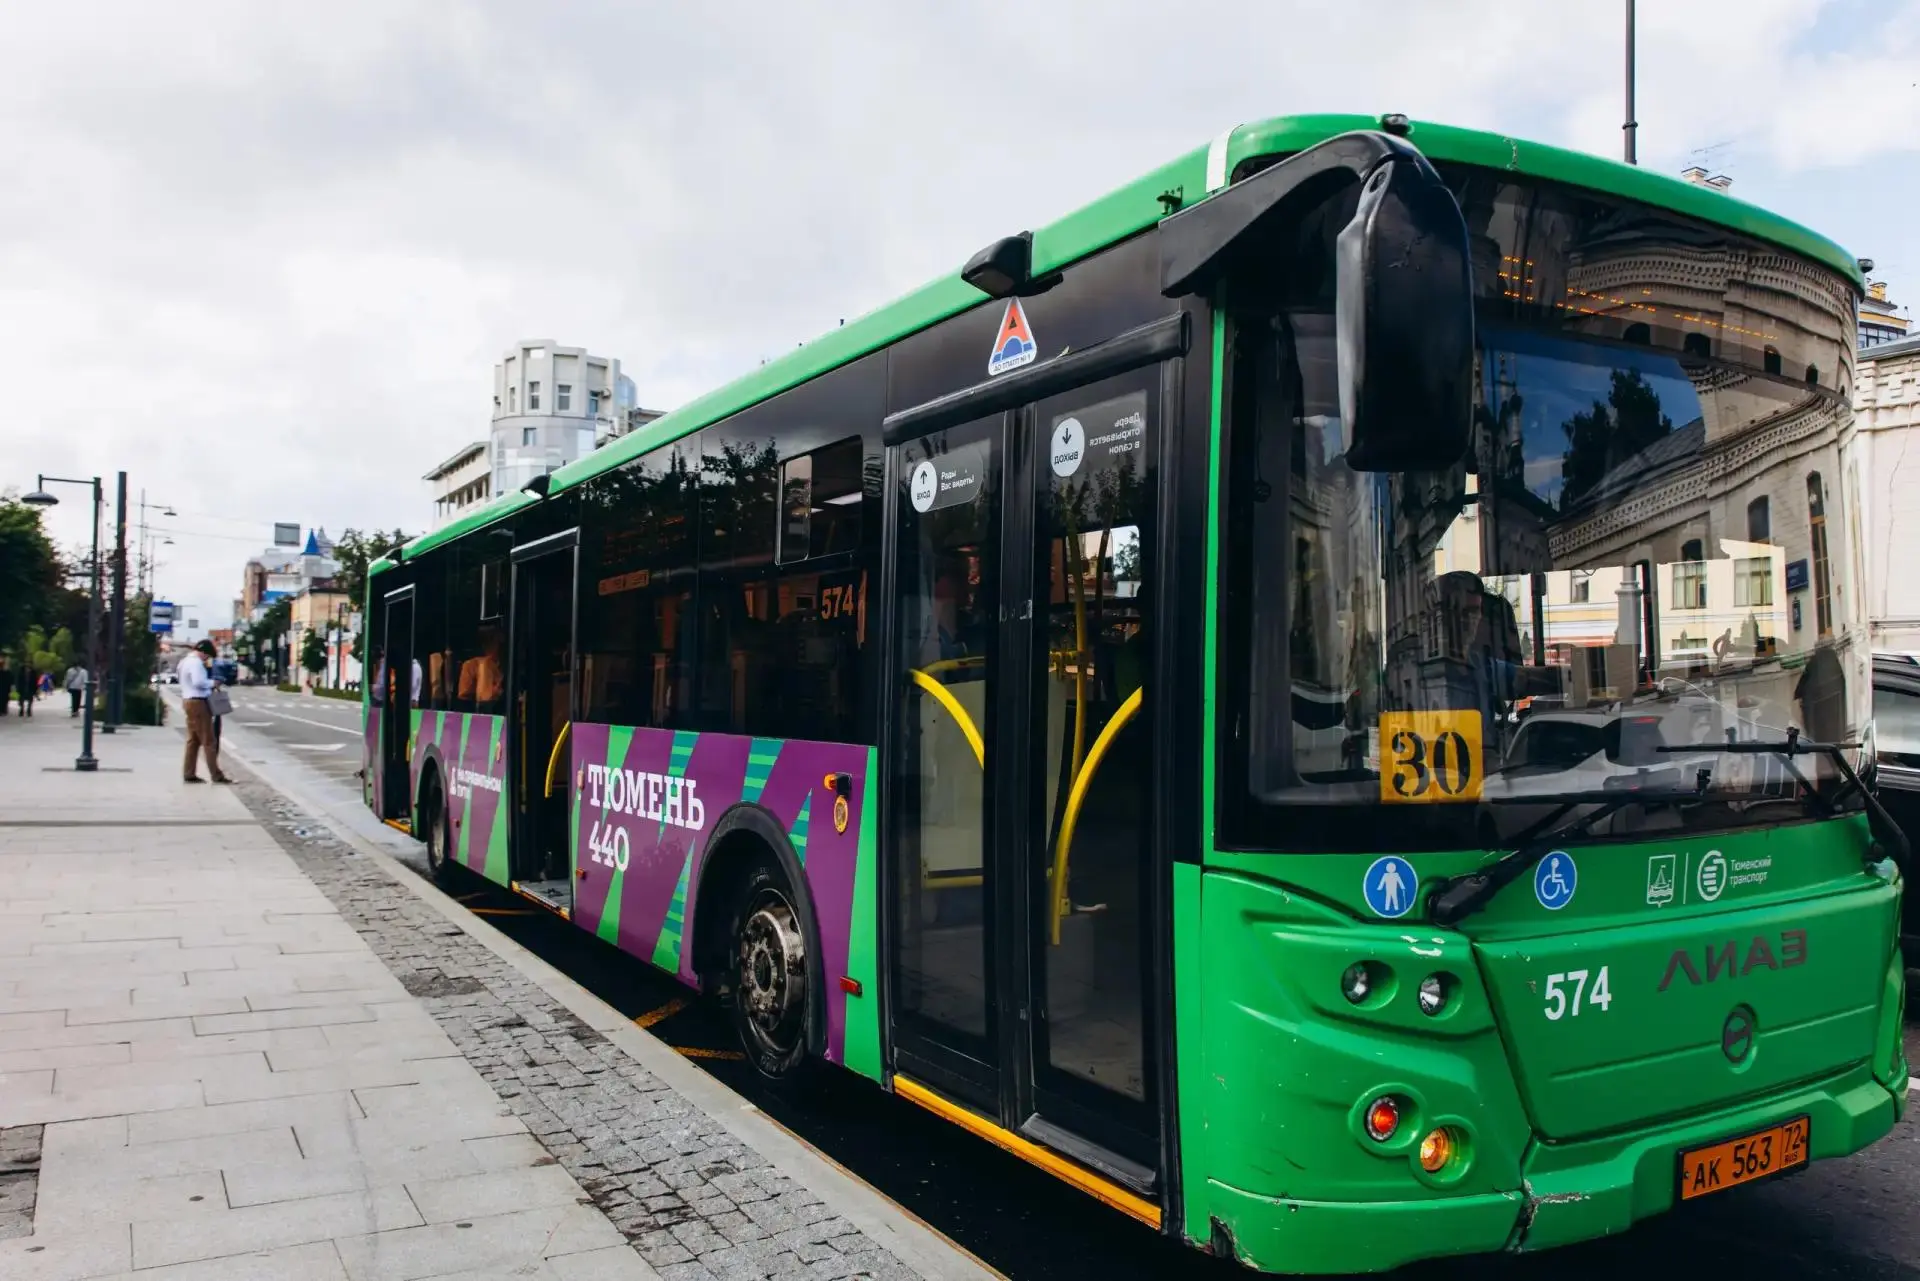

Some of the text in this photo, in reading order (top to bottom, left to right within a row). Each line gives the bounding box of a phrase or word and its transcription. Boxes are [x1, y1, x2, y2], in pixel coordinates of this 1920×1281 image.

[941, 469, 957, 480] Рады
[821, 584, 854, 619] 574
[1391, 731, 1471, 797] 30
[587, 763, 705, 831] ТЮМЕНЬ
[588, 820, 630, 872] 440
[1730, 855, 1772, 872] Тюменский
[1729, 871, 1768, 888] транспорт
[1656, 927, 1808, 992] ЛИАЗ
[1544, 966, 1612, 1020] 574
[1732, 1135, 1773, 1179] 563
[1784, 1123, 1802, 1154] 72
[1784, 1151, 1800, 1165] RUS
